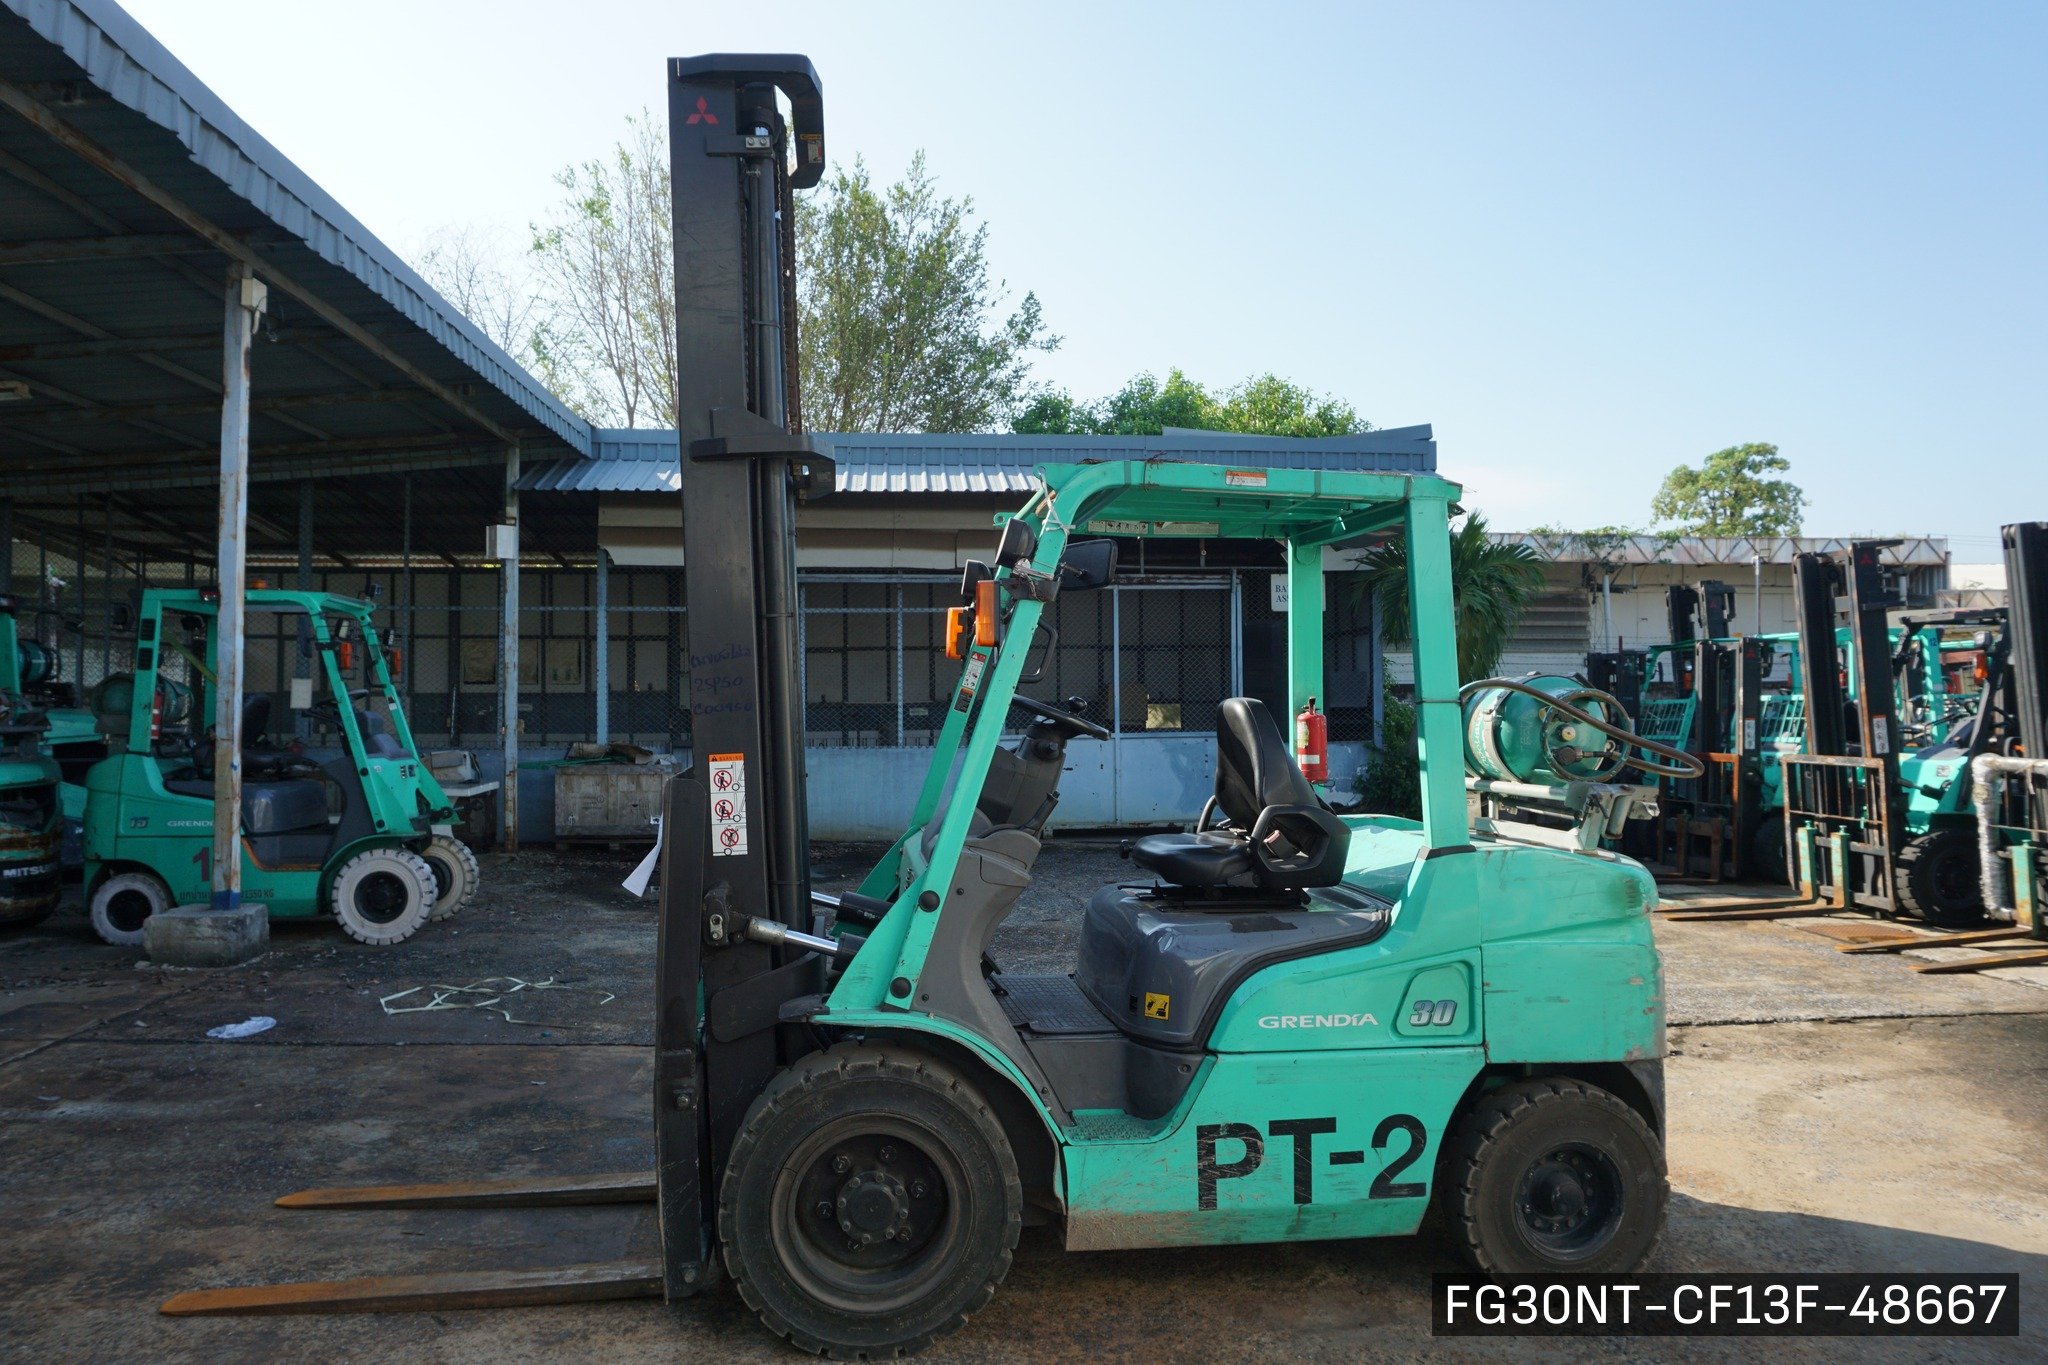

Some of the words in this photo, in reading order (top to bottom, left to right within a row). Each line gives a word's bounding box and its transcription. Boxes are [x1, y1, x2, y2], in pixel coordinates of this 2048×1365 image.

[1275, 585, 1288, 593] BA
[1409, 1000, 1458, 1027] 30
[1196, 1113, 1428, 1212] PT-2
